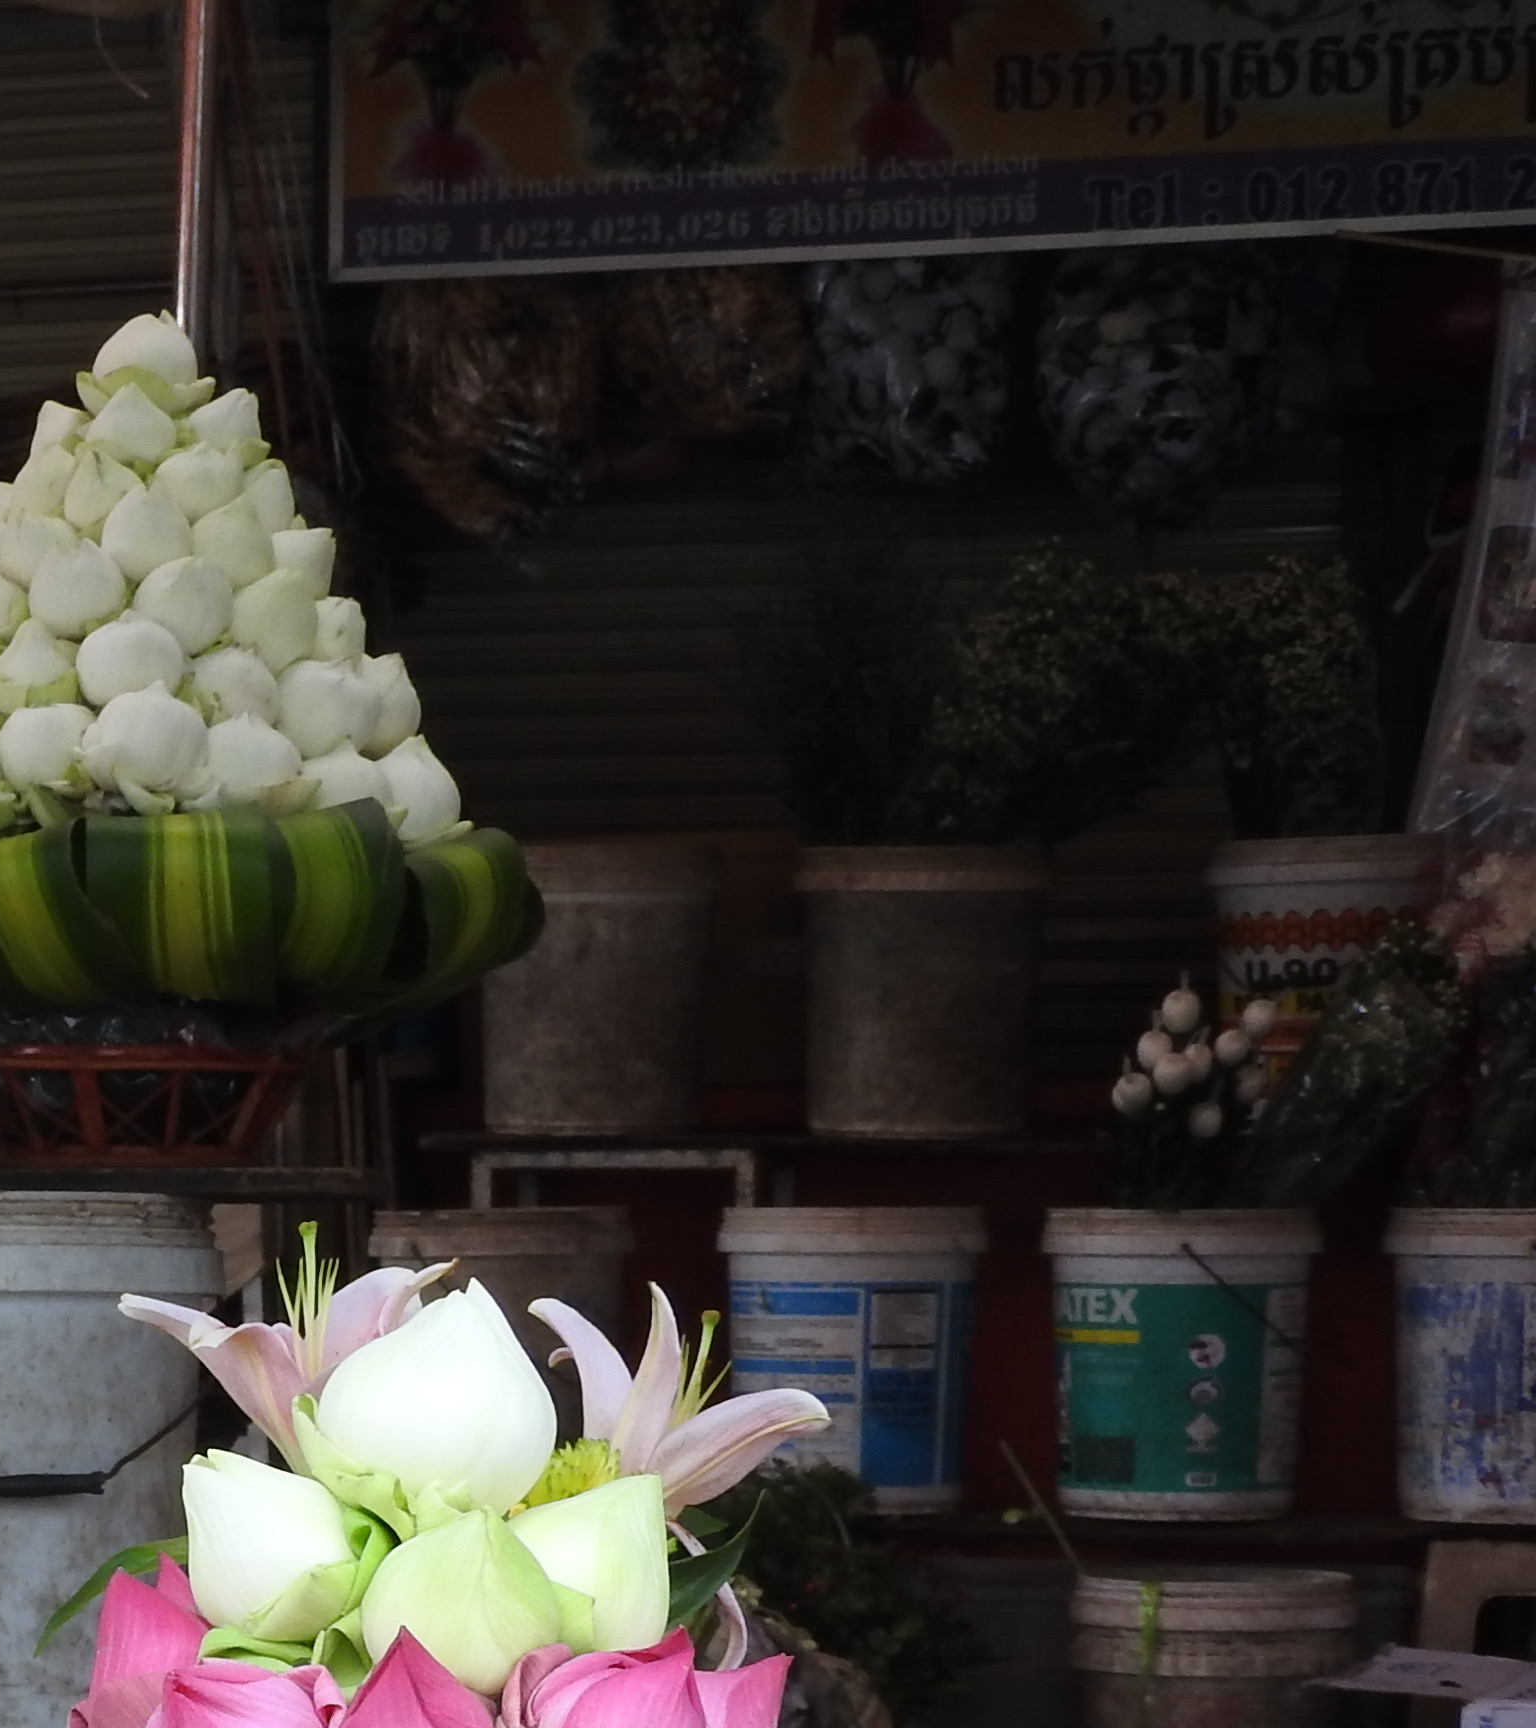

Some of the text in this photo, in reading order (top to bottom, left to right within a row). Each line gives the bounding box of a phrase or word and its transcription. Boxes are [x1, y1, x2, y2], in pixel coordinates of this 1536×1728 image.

[498, 172, 577, 200] kinds
[879, 155, 1038, 182] decoration
[1087, 172, 1180, 231] Tel
[1245, 165, 1349, 224] 012
[1375, 156, 1476, 217] 871
